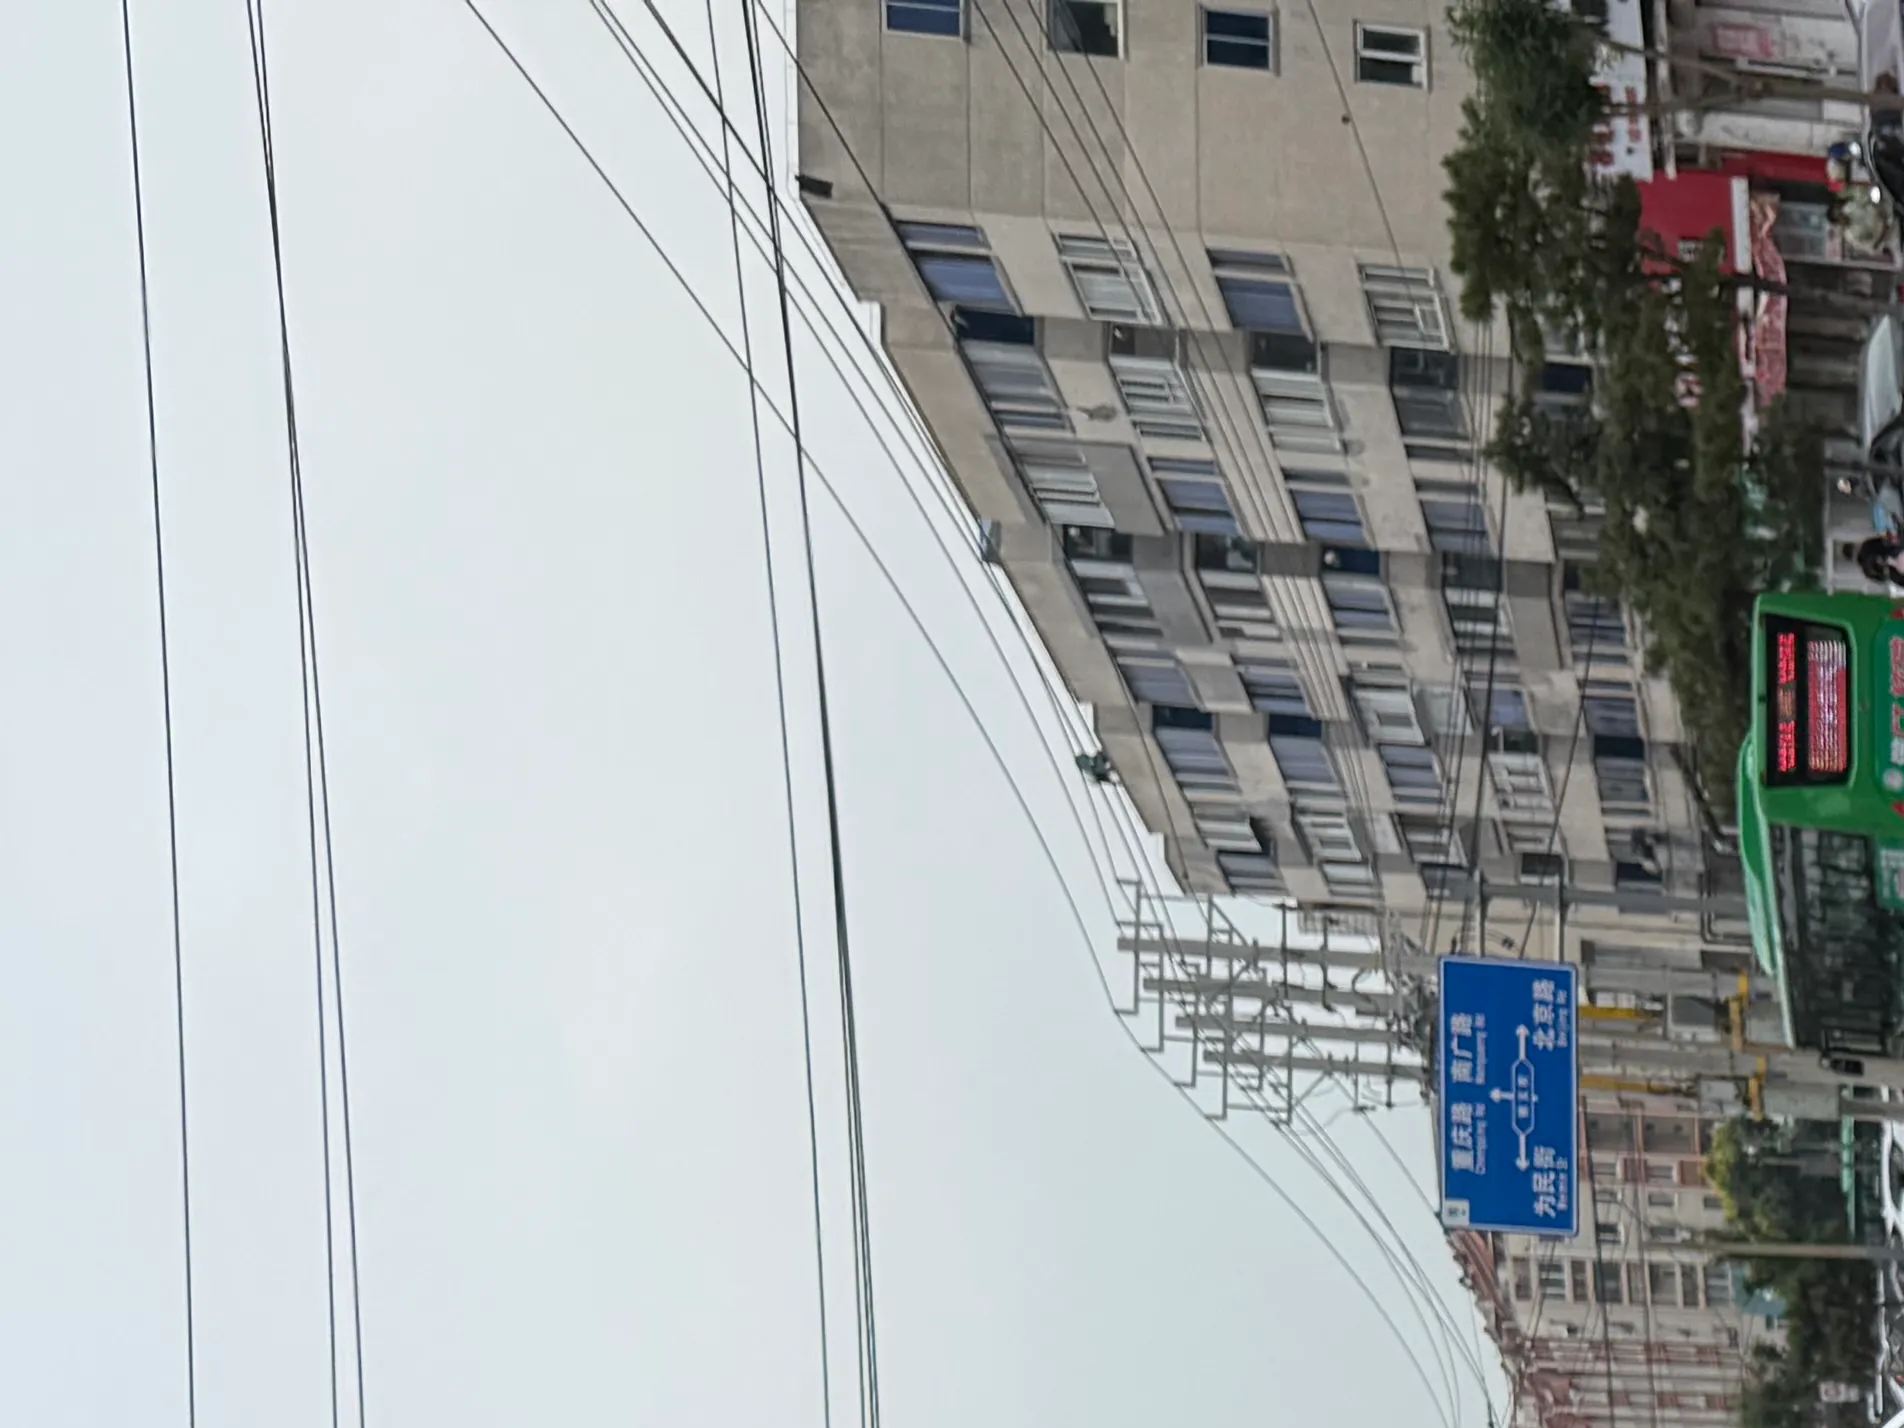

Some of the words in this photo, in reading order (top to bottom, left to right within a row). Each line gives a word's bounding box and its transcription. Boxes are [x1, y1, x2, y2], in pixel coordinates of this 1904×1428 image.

[1450, 1012, 1475, 1083] 南广路
[1532, 978, 1555, 1051] 北京路
[1450, 1102, 1475, 1172] 重庆路
[1533, 1145, 1557, 1218] 为民街
